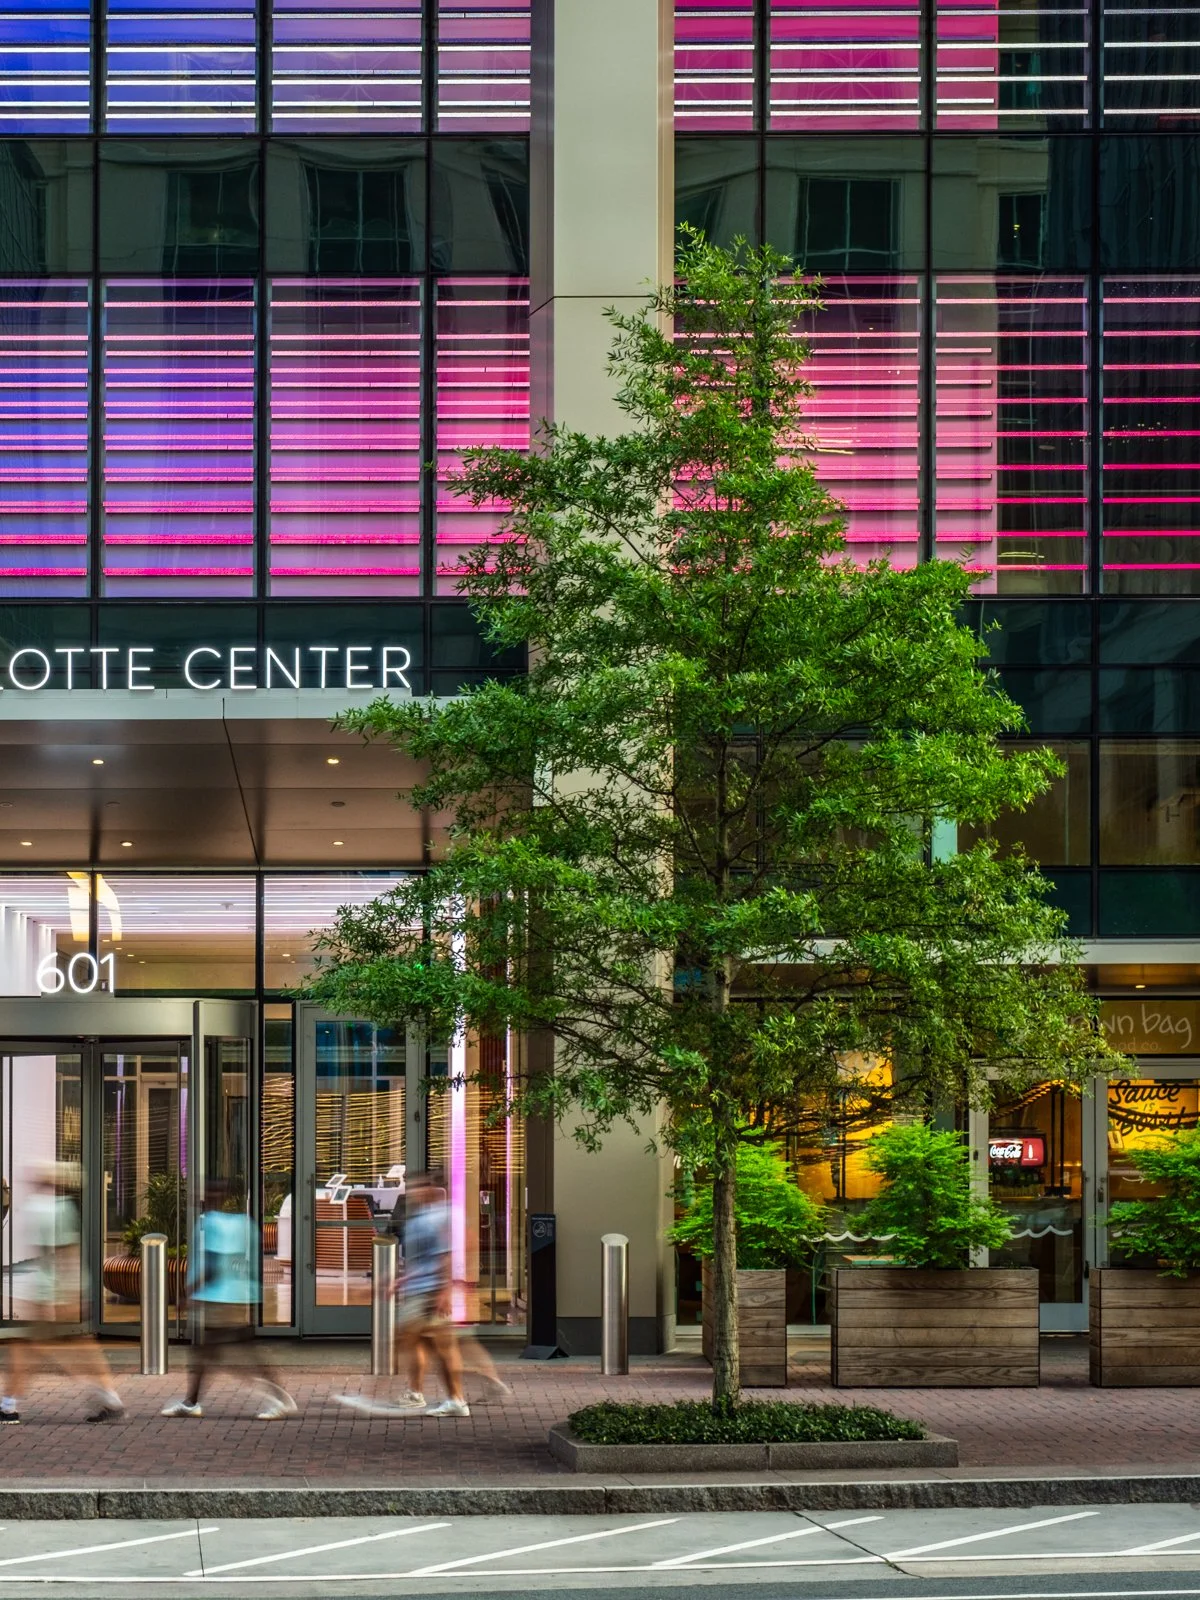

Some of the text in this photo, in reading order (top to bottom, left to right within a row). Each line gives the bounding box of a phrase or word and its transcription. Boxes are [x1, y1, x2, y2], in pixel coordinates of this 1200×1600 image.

[184, 646, 412, 690] CENTER
[36, 951, 115, 994] 601
[1141, 1003, 1192, 1049] bag
[1109, 1080, 1180, 1104] Sauce
